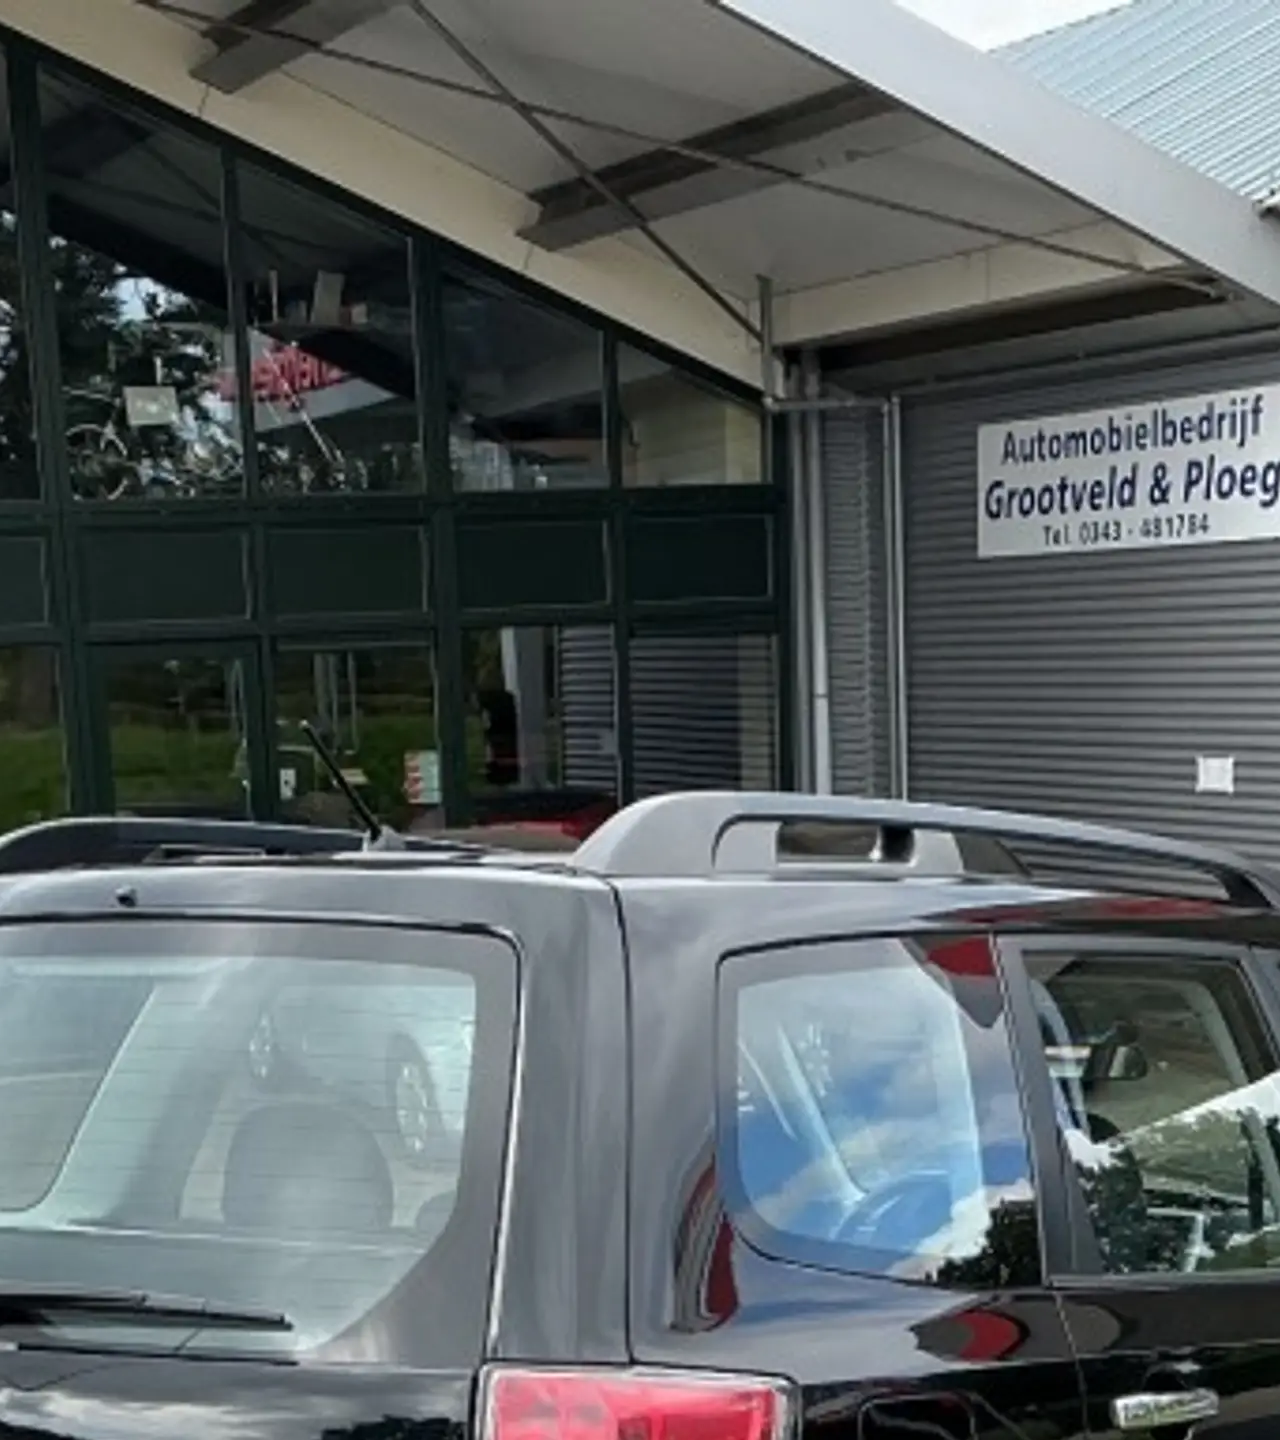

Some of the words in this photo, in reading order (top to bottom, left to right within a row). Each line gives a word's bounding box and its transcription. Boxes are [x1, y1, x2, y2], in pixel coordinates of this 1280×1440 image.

[1001, 394, 1264, 464] Automobielbedrijf
[985, 463, 1138, 520] Grootveld
[1149, 462, 1173, 505] &
[1079, 521, 1121, 545] 0343
[1139, 513, 1210, 539] 481784
